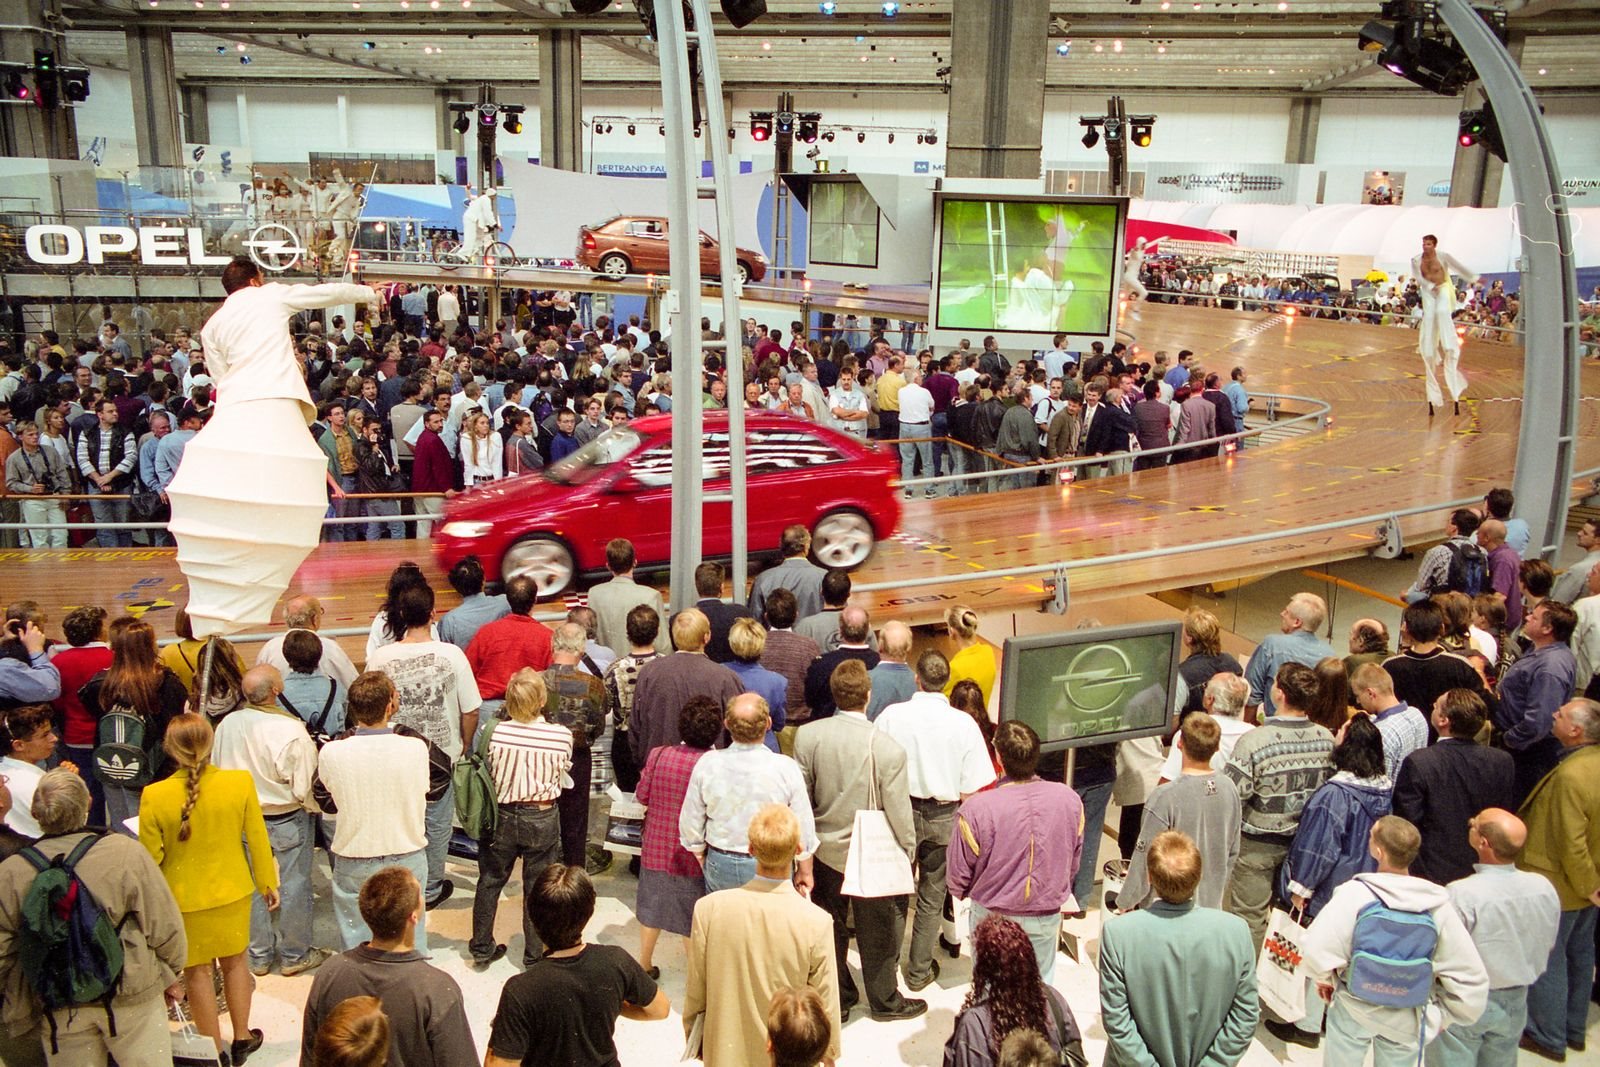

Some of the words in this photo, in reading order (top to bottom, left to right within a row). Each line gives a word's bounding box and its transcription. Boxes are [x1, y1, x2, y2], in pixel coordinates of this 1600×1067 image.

[597, 164, 647, 172] BERTRAND
[25, 225, 232, 265] OPEL
[1060, 715, 1131, 738] OPEL
